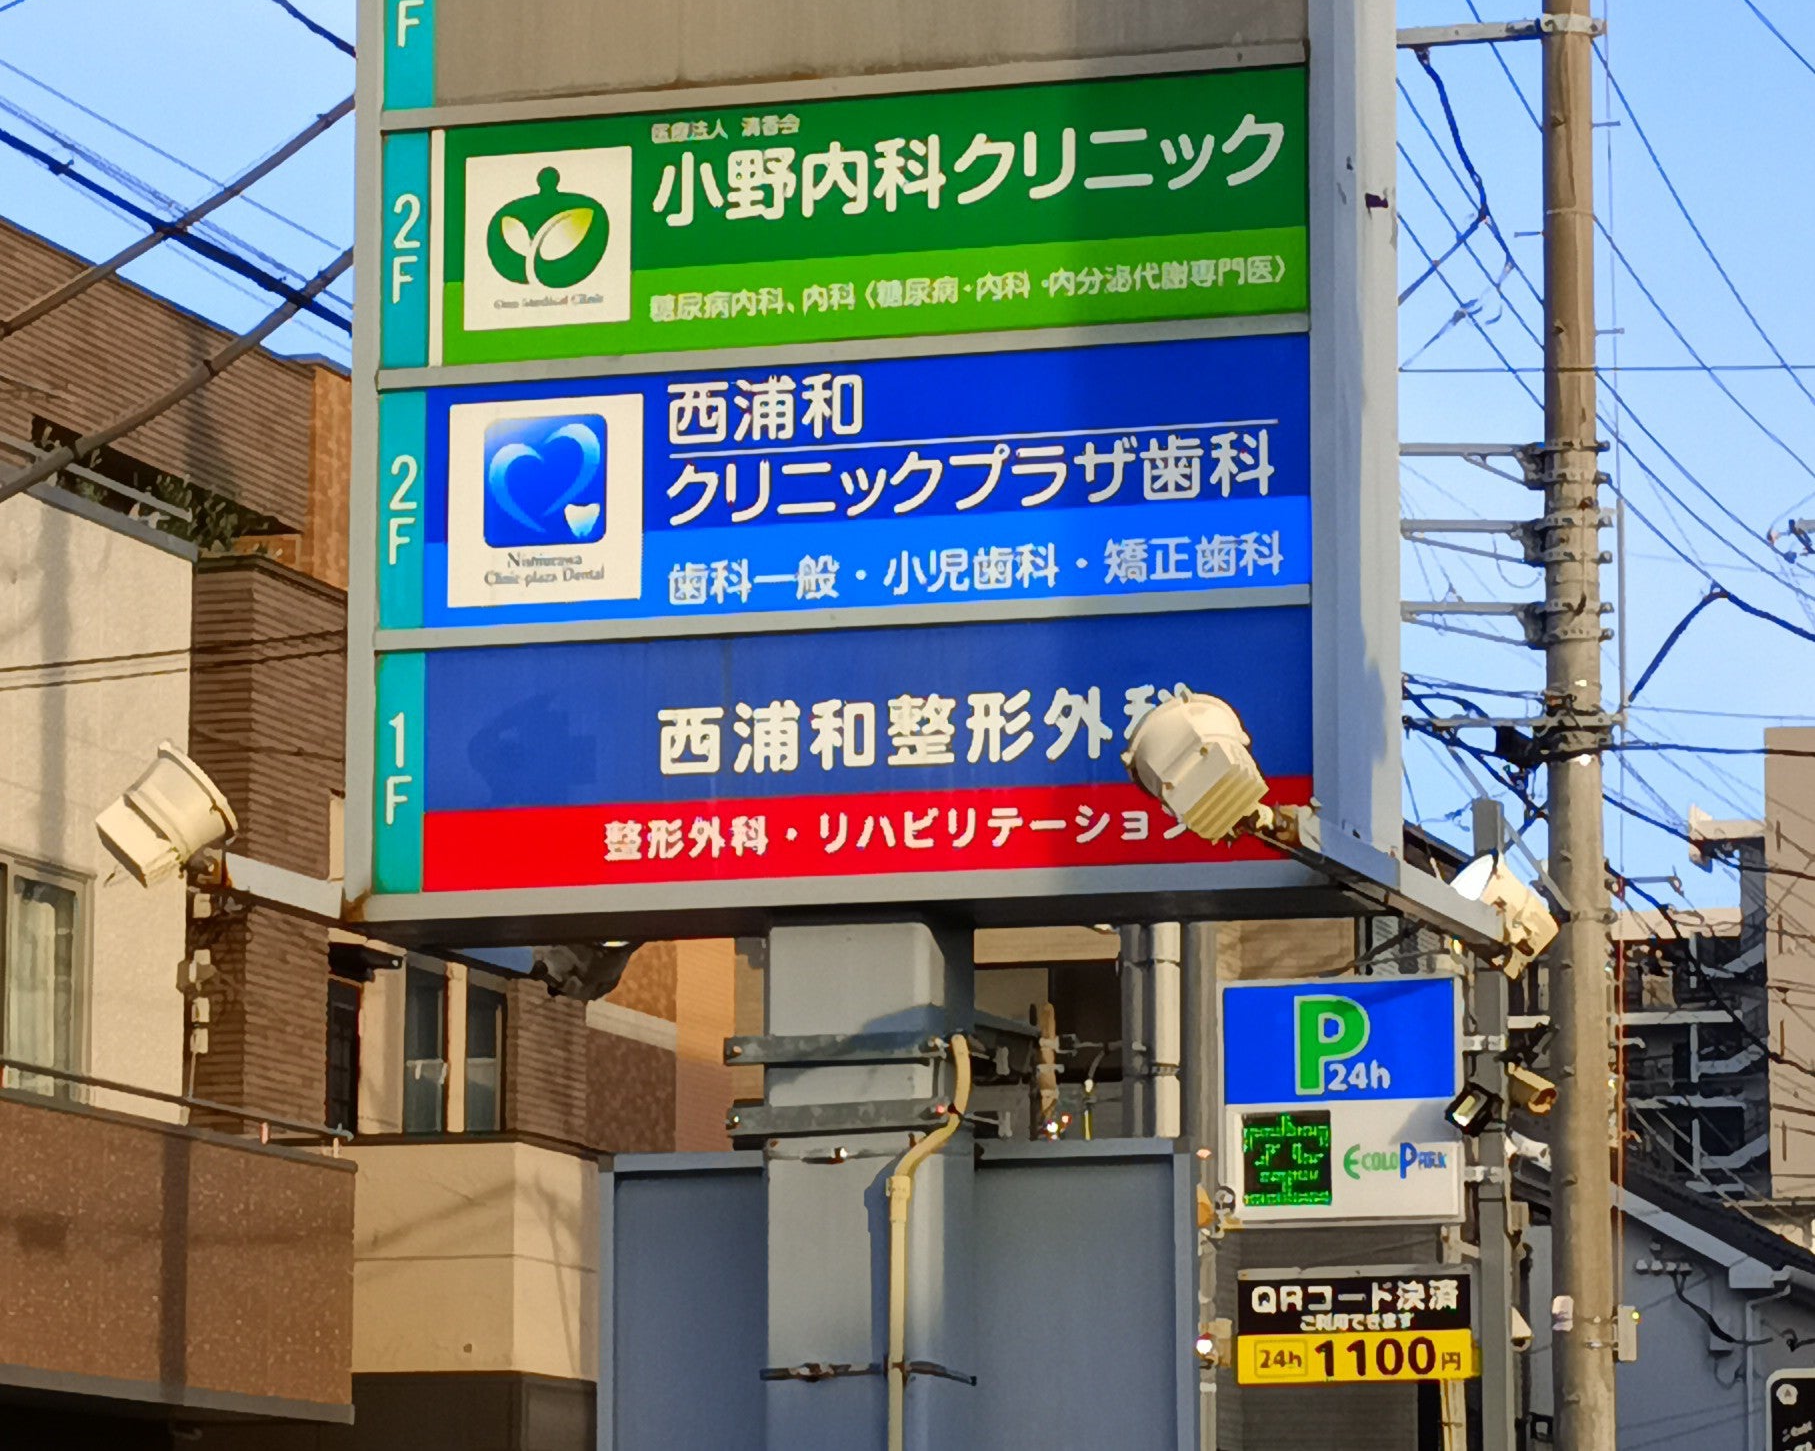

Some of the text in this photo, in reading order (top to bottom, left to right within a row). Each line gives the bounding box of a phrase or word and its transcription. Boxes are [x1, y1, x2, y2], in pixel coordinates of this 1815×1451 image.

[651, 112, 1286, 228] 小野内科クリニック
[391, 193, 422, 304] 2F
[667, 374, 865, 444] 西浦和
[388, 453, 419, 566] 2F
[667, 428, 1277, 526] クリニックプラザ歯科
[385, 711, 414, 825] 1F
[1294, 995, 1371, 1096] P
[1328, 1061, 1391, 1092] 24h
[1251, 1279, 1459, 1314] QRコード決済
[1259, 1349, 1303, 1369] 24h
